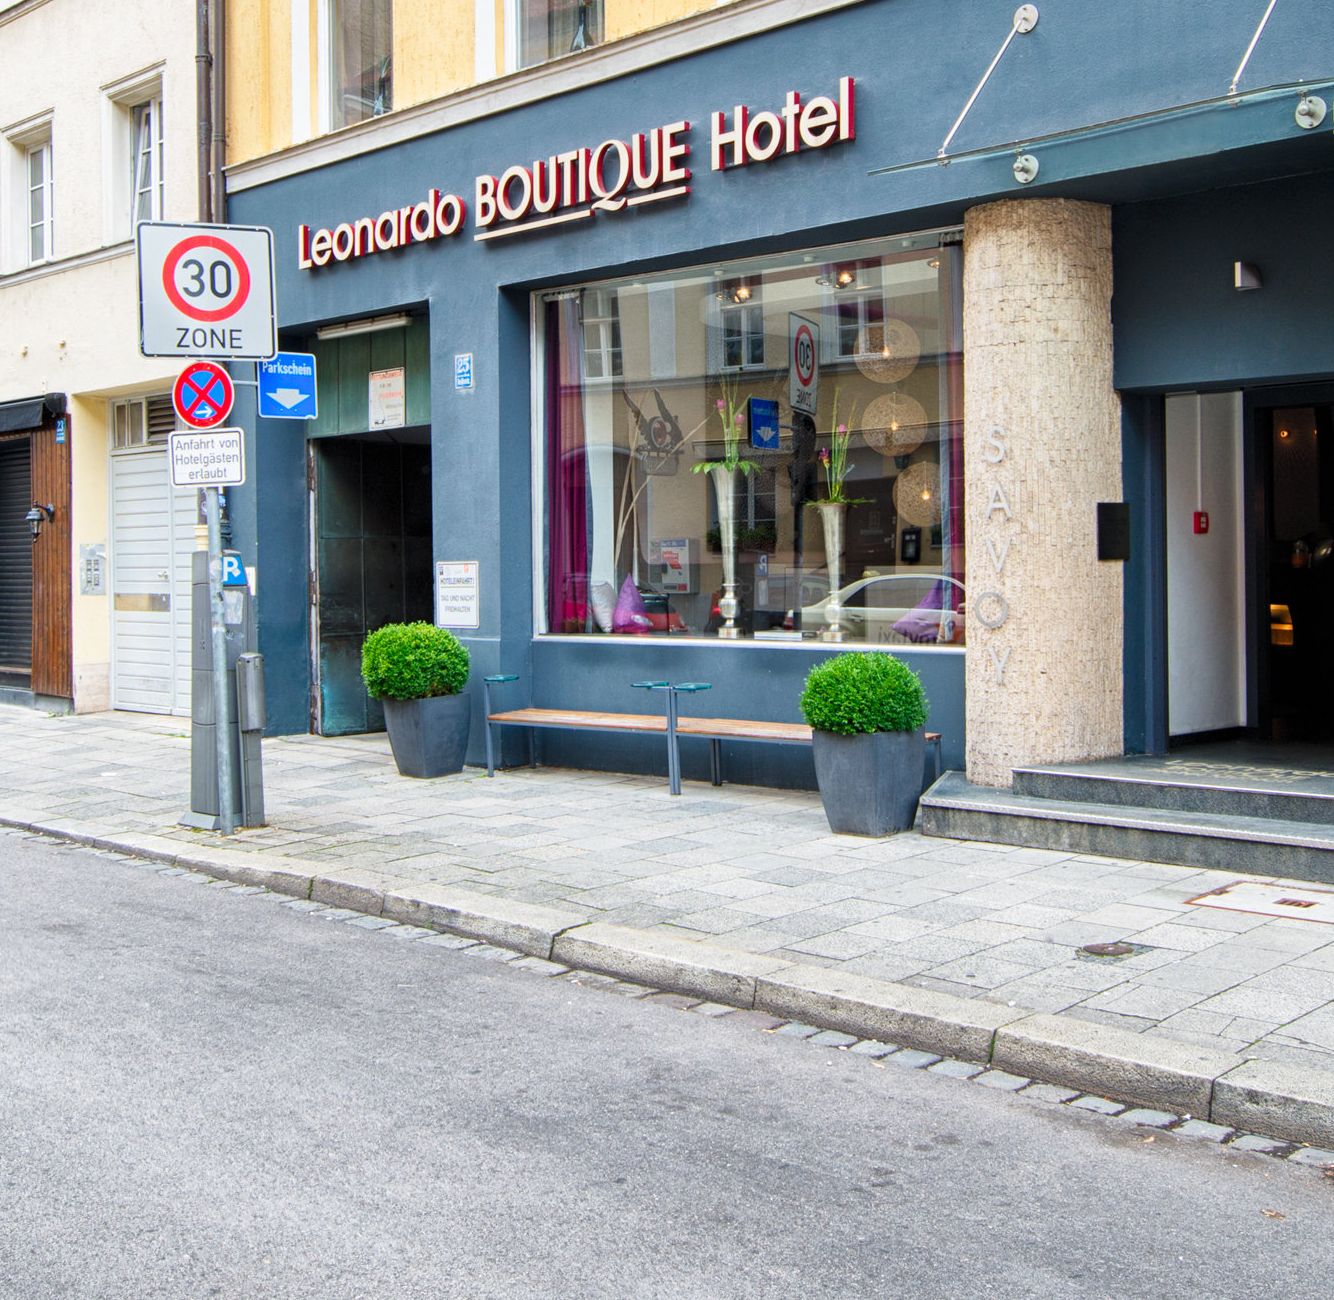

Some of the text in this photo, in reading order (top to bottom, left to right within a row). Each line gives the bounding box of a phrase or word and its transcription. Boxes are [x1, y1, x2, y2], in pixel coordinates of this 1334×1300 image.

[298, 76, 855, 270] Leonardo BOUTIQUE Hotel
[181, 258, 232, 298] 30
[176, 327, 243, 349] ZONE
[262, 359, 313, 376] Parkschein
[458, 357, 470, 373] 25
[175, 434, 239, 451] Anfahrt von
[175, 452, 239, 467] Hotelgästen
[188, 467, 228, 481] erlaubt
[974, 425, 1014, 685] SAVOY
